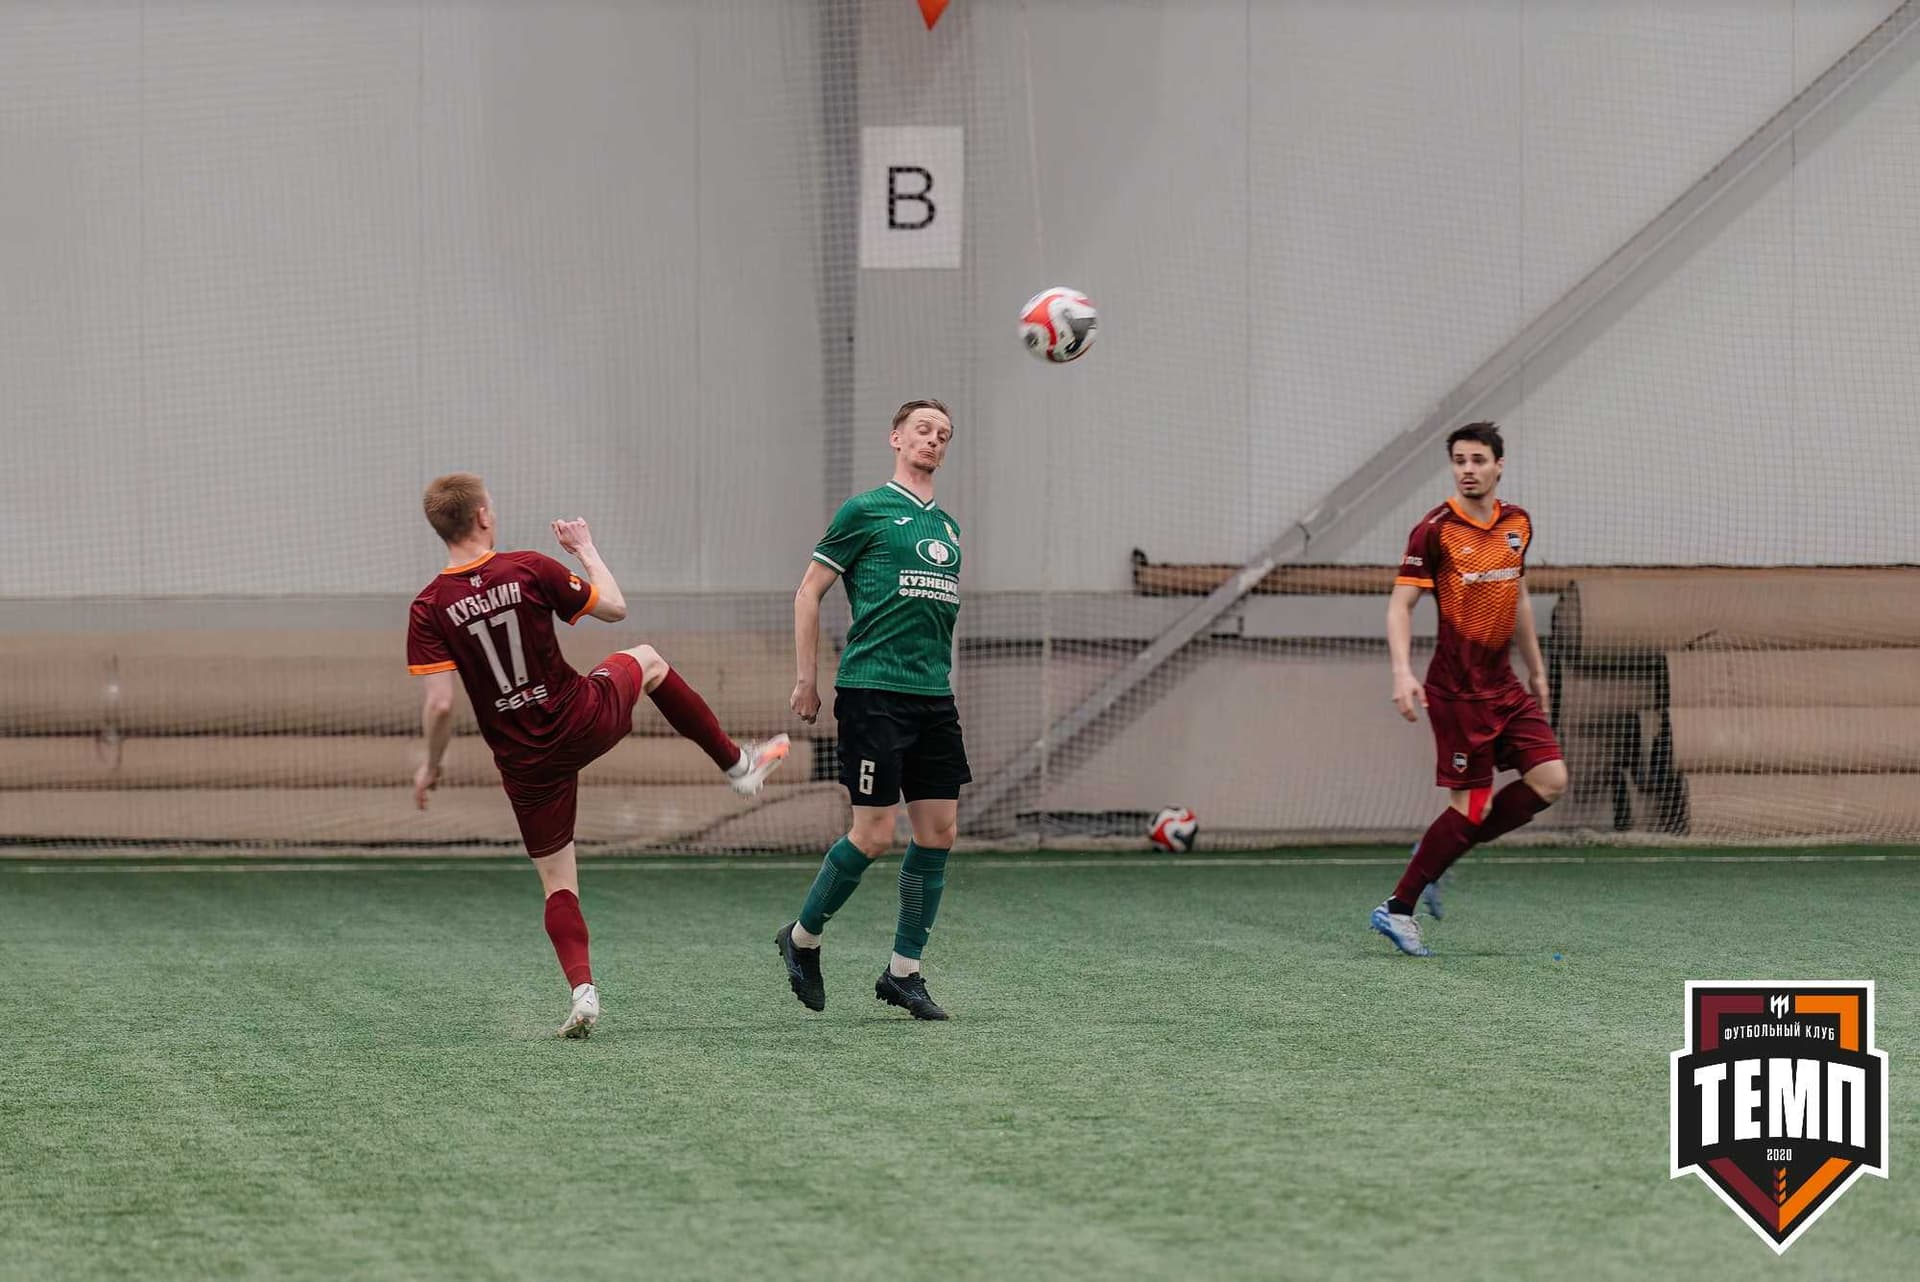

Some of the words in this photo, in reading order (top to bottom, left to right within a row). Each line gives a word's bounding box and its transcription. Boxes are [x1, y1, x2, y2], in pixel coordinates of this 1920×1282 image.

[446, 582, 521, 627] КУЗЬКИН
[467, 609, 529, 695] 17
[495, 684, 548, 712] SELS
[859, 759, 875, 795] 6
